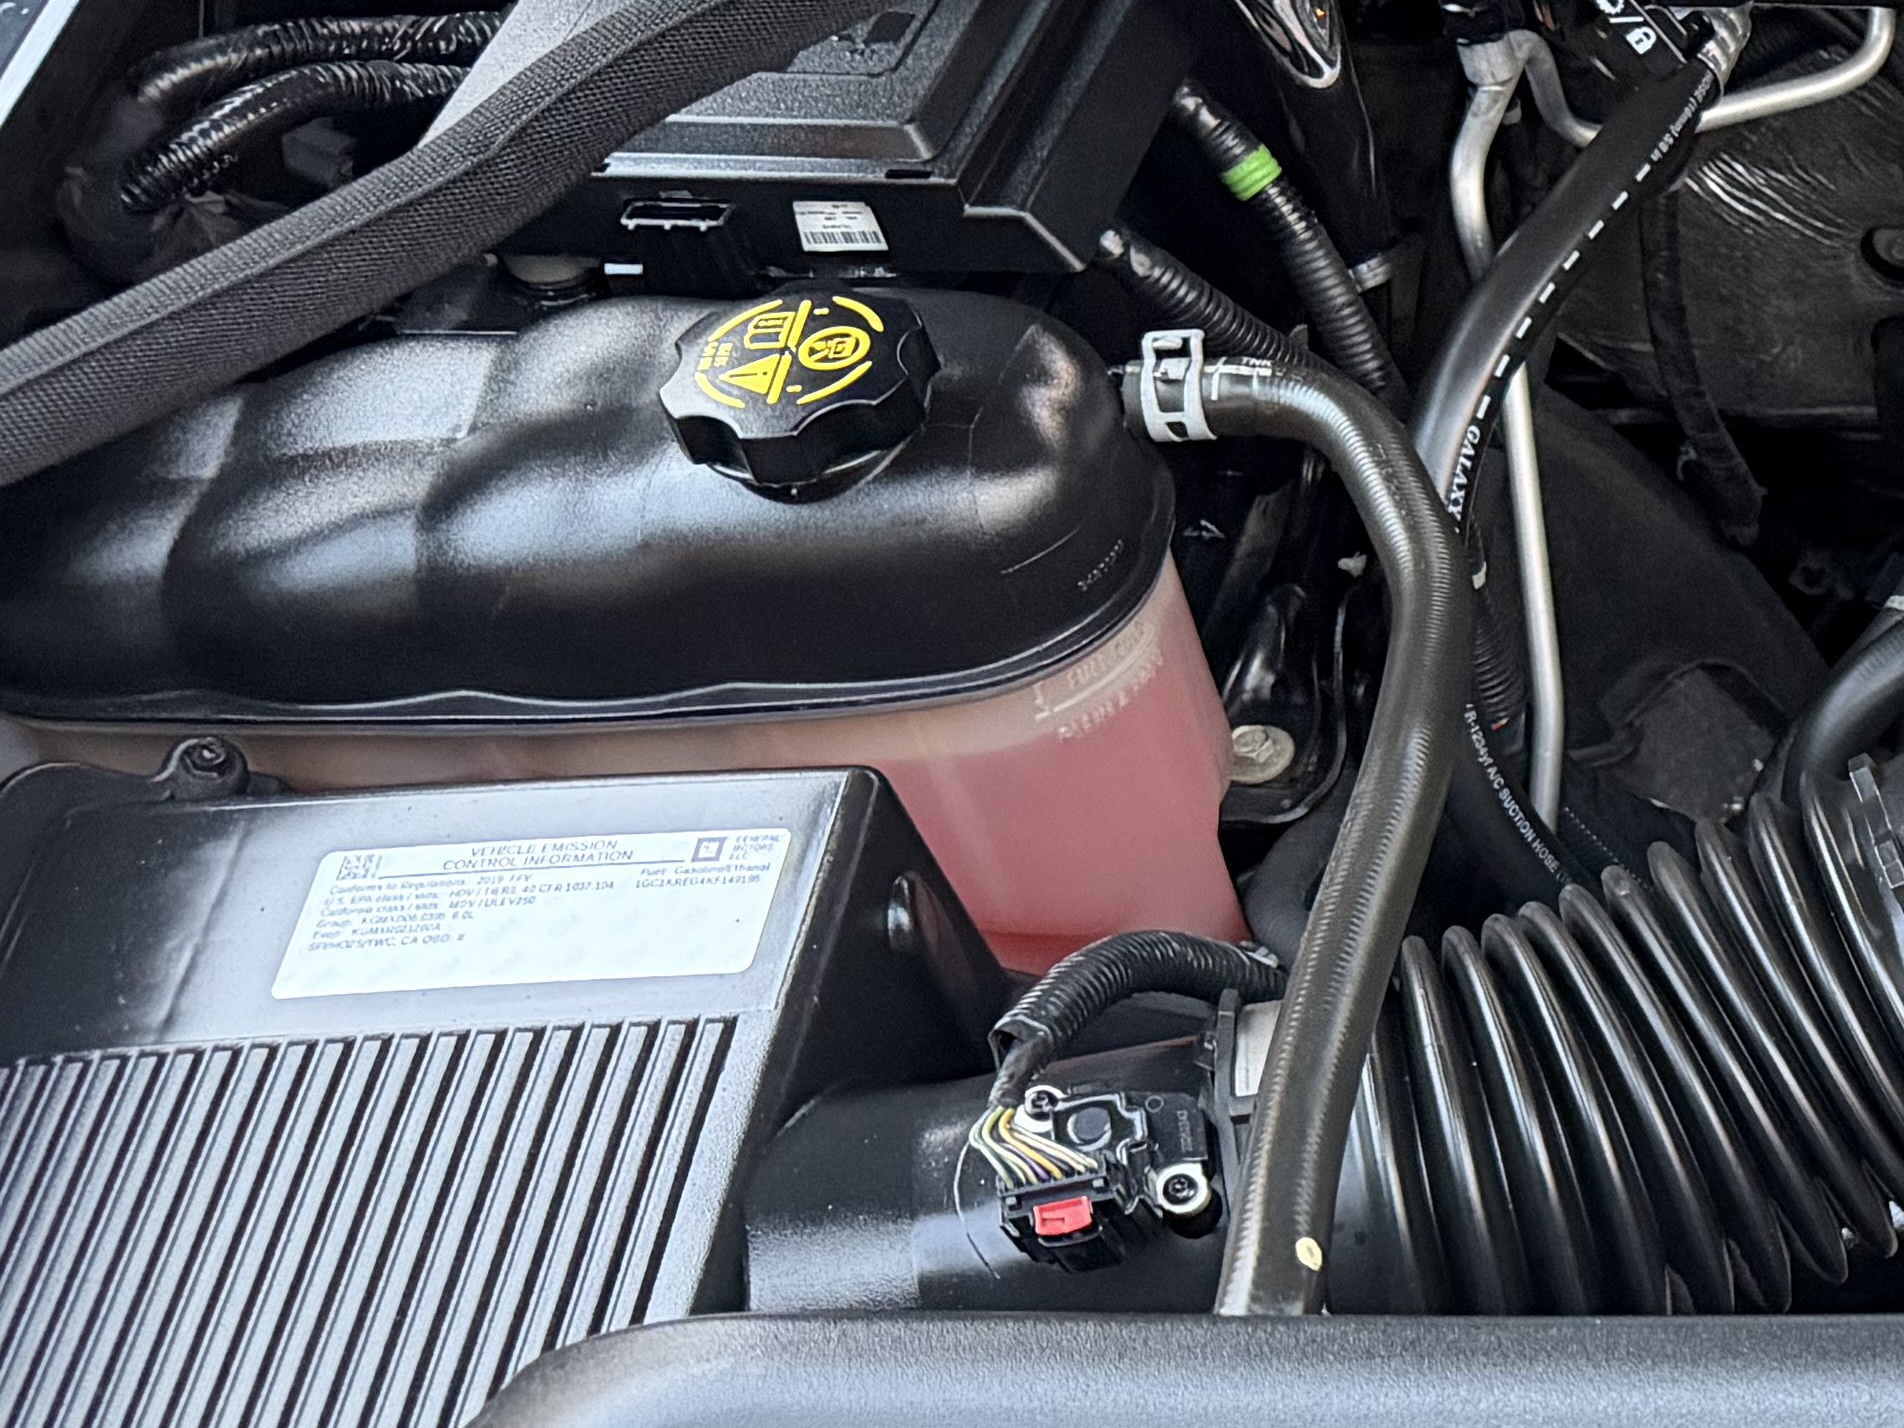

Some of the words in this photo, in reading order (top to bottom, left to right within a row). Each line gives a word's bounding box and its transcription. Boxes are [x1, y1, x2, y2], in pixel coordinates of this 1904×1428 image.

[1447, 424, 1480, 522] GALAXY
[472, 843, 536, 857] VEHICLE
[541, 840, 618, 854] EMISSION
[1499, 787, 1537, 843] SUCTION
[1532, 838, 1561, 873] HOSE
[443, 856, 520, 871] CONTROL
[524, 850, 634, 866] INFORMATION
